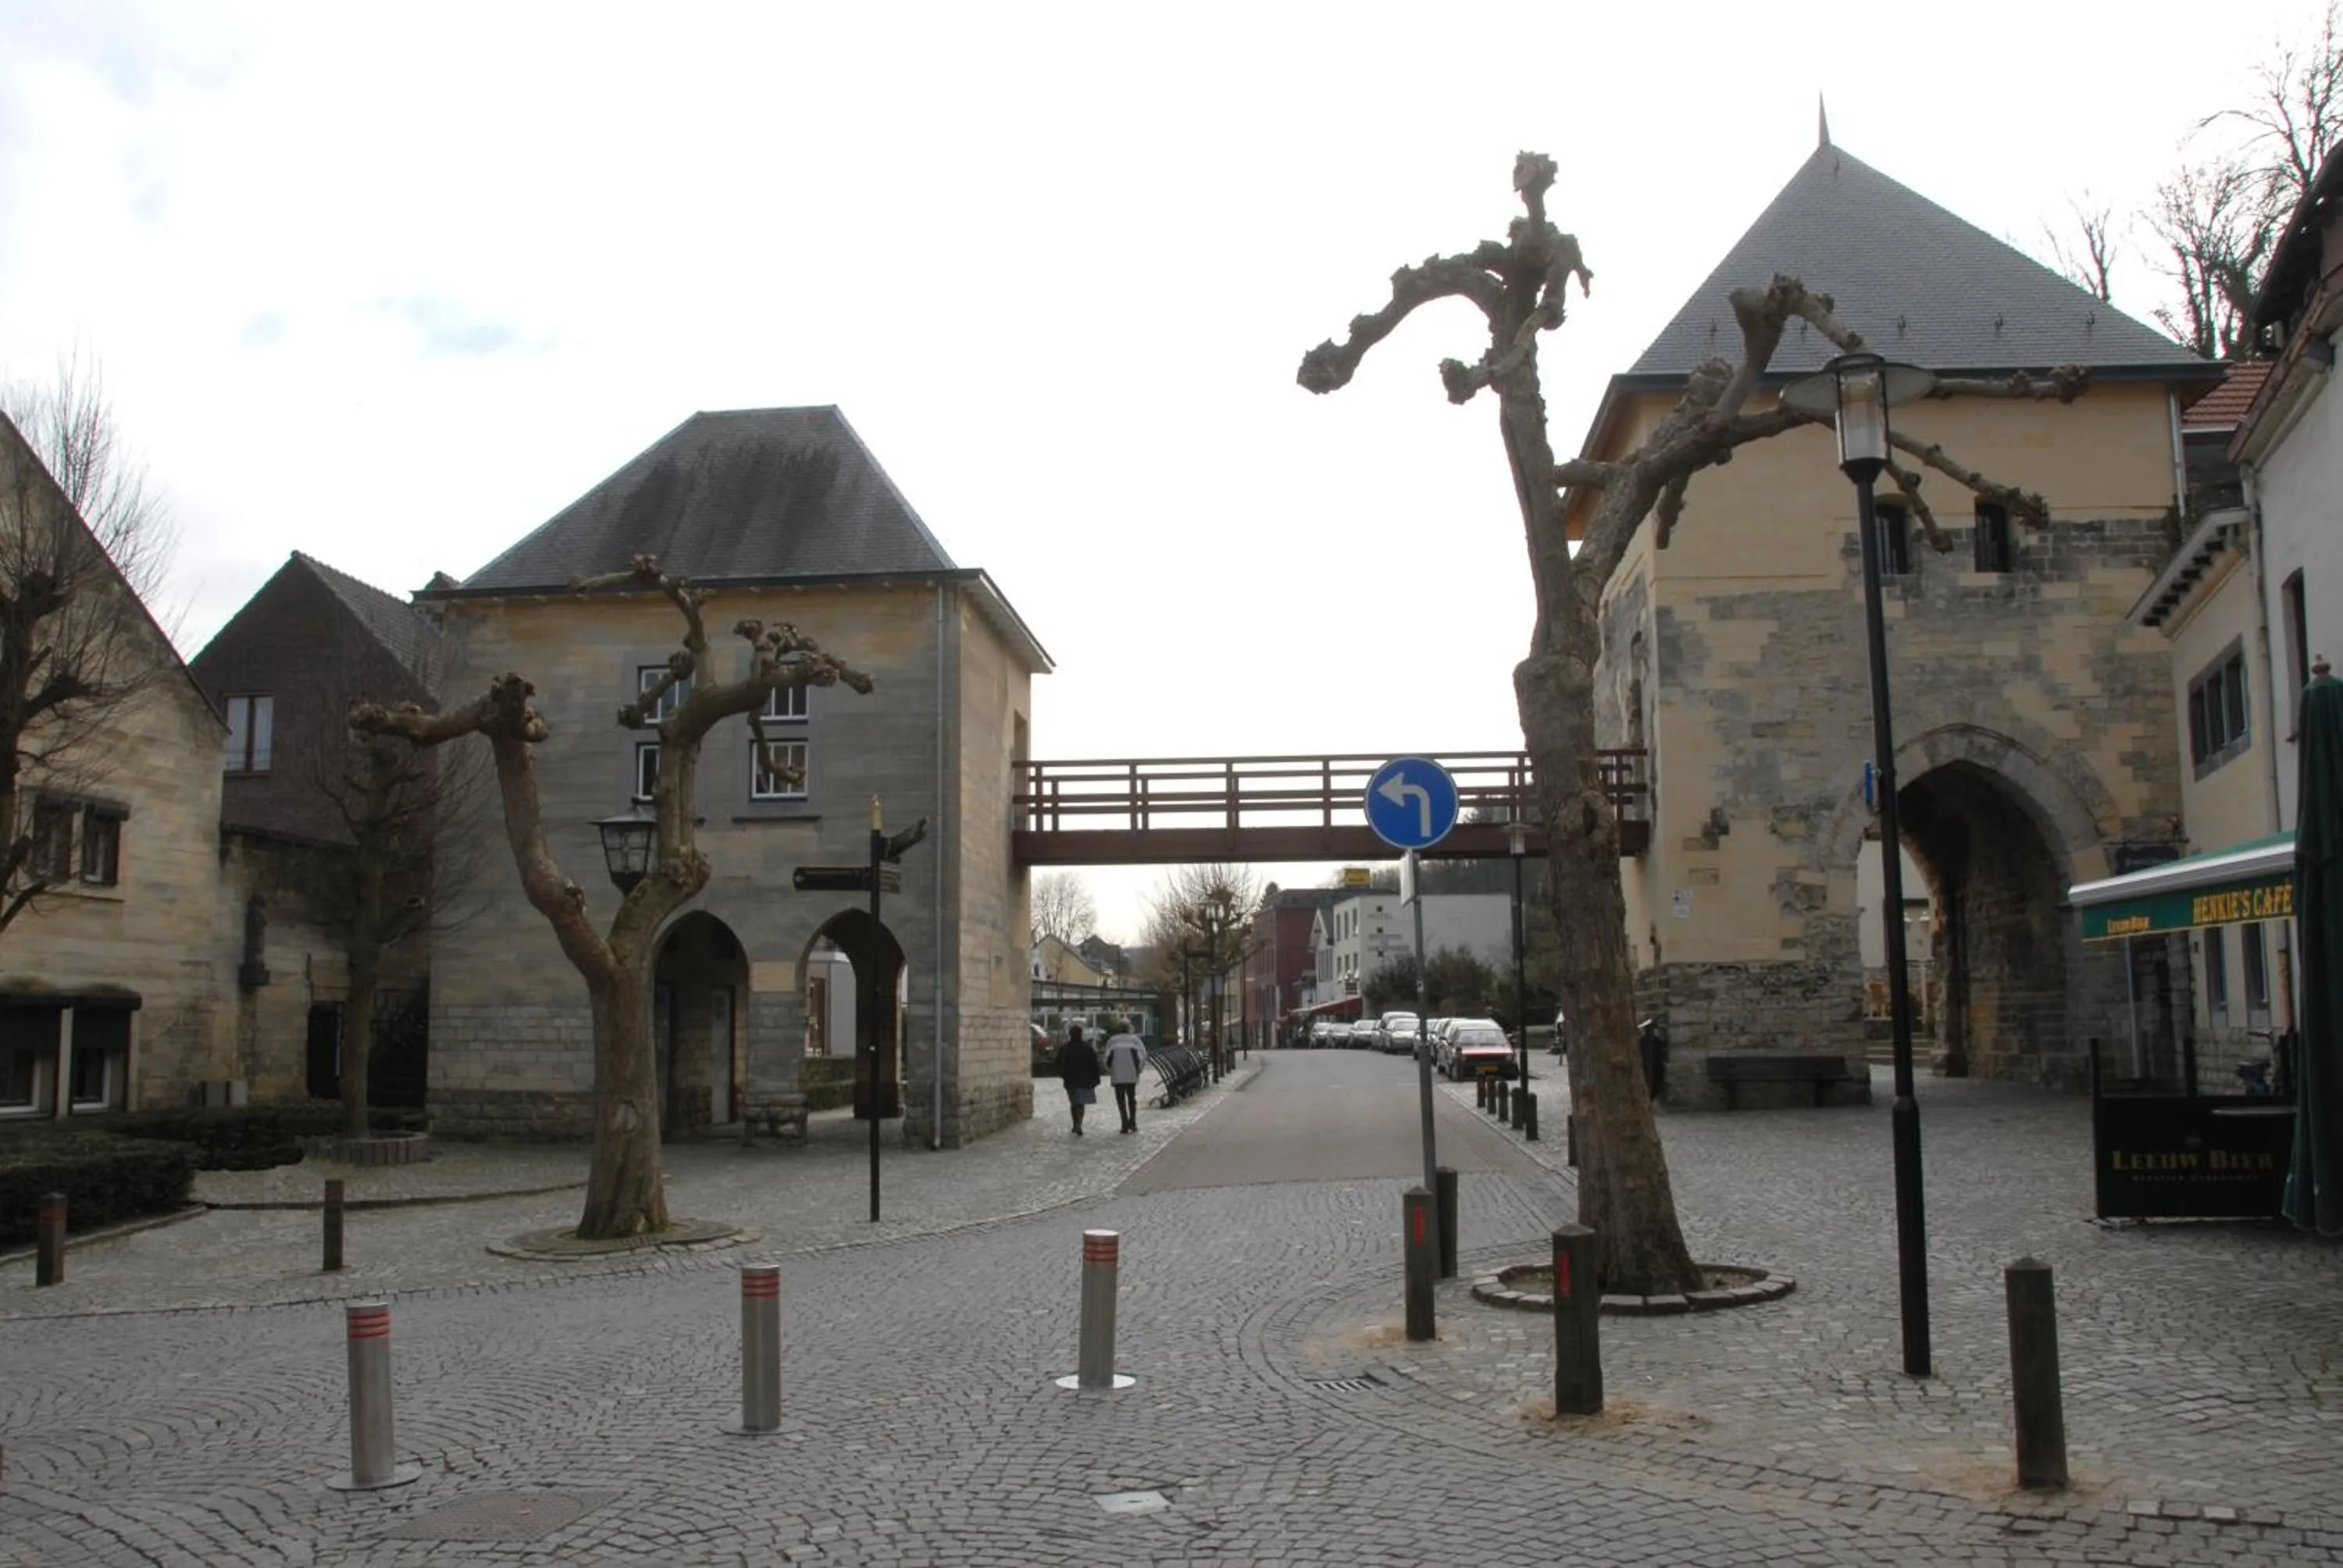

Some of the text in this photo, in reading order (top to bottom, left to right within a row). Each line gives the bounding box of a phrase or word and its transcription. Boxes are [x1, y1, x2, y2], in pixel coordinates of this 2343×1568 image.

[2194, 889, 2250, 925] HENKIE'S
[2112, 1150, 2275, 1171] LEEUW BIER
